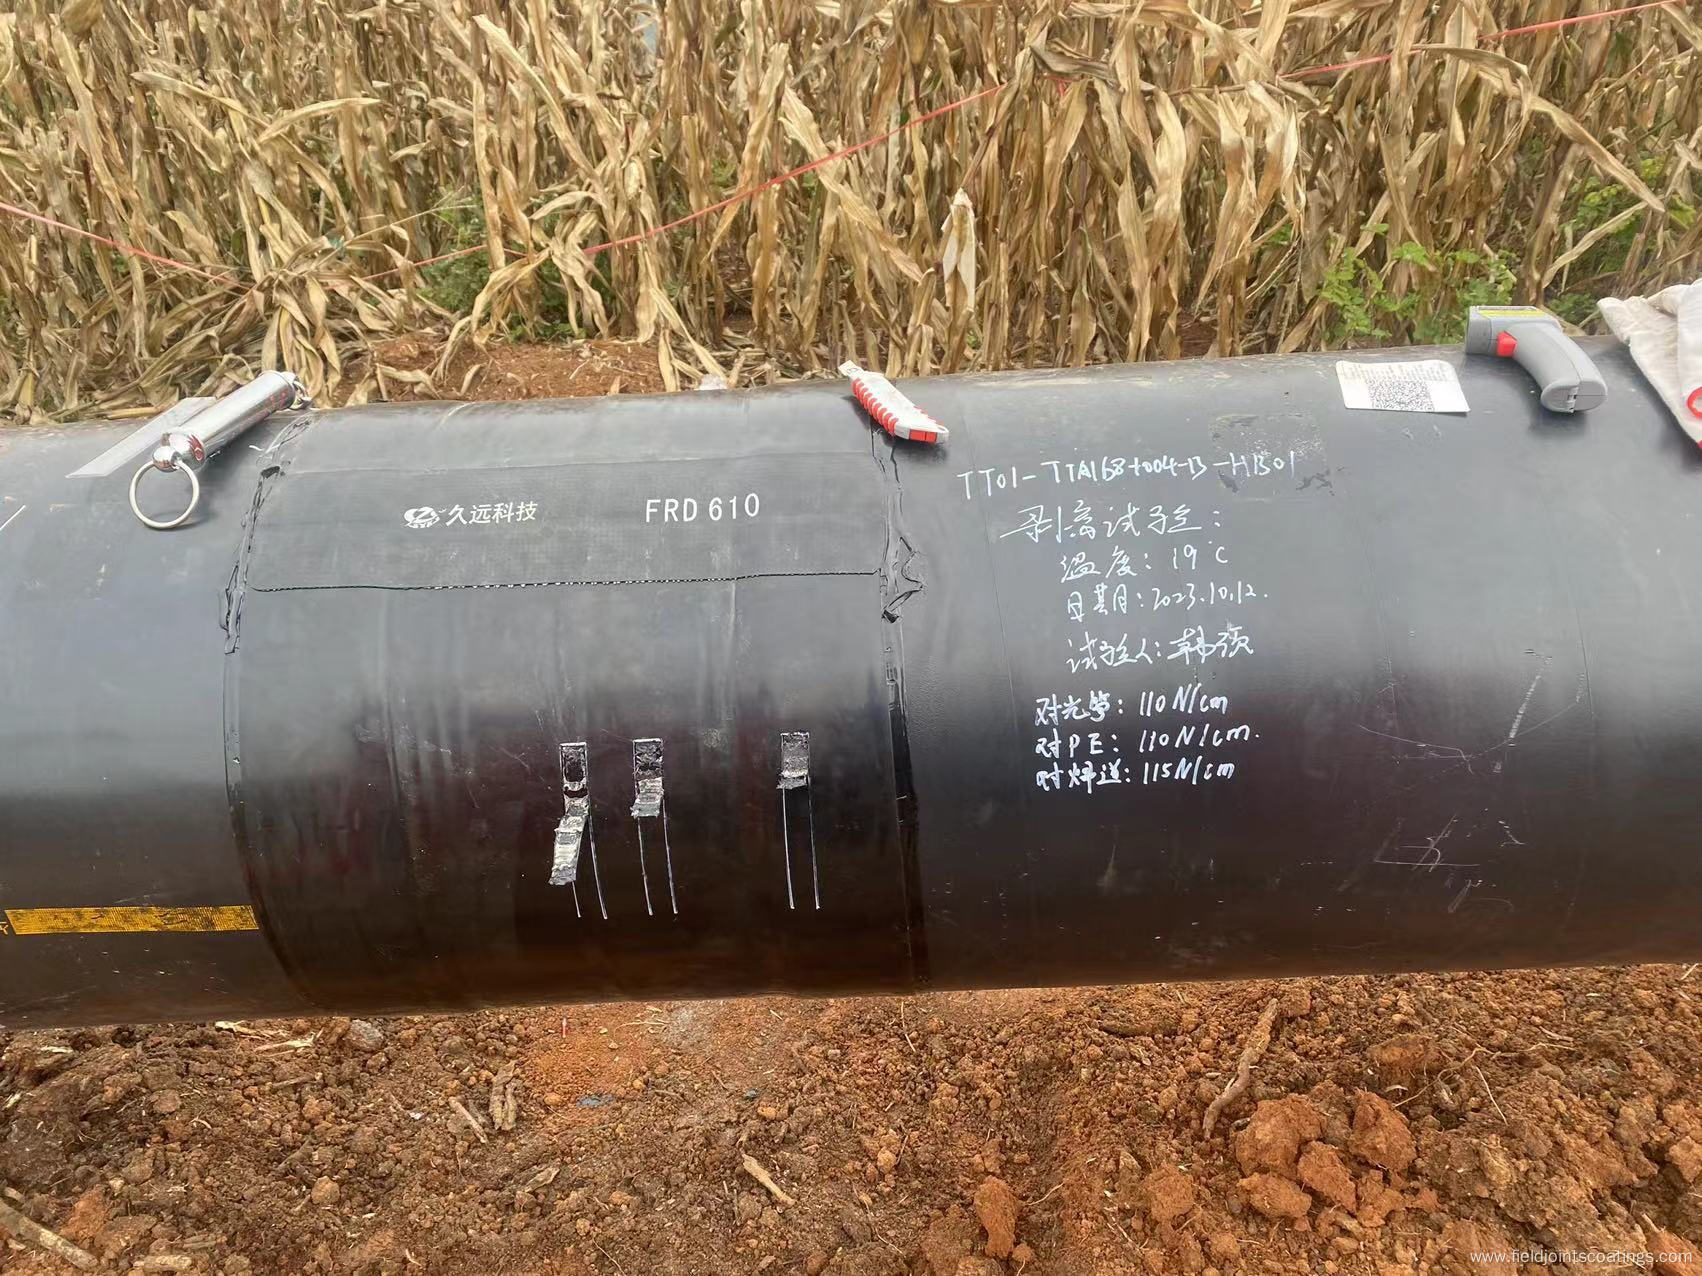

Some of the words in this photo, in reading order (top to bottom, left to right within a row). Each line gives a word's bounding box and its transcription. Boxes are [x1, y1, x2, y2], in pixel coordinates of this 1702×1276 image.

[445, 500, 538, 527] 久远科技
[645, 498, 698, 522] FRD
[708, 492, 760, 521] 610
